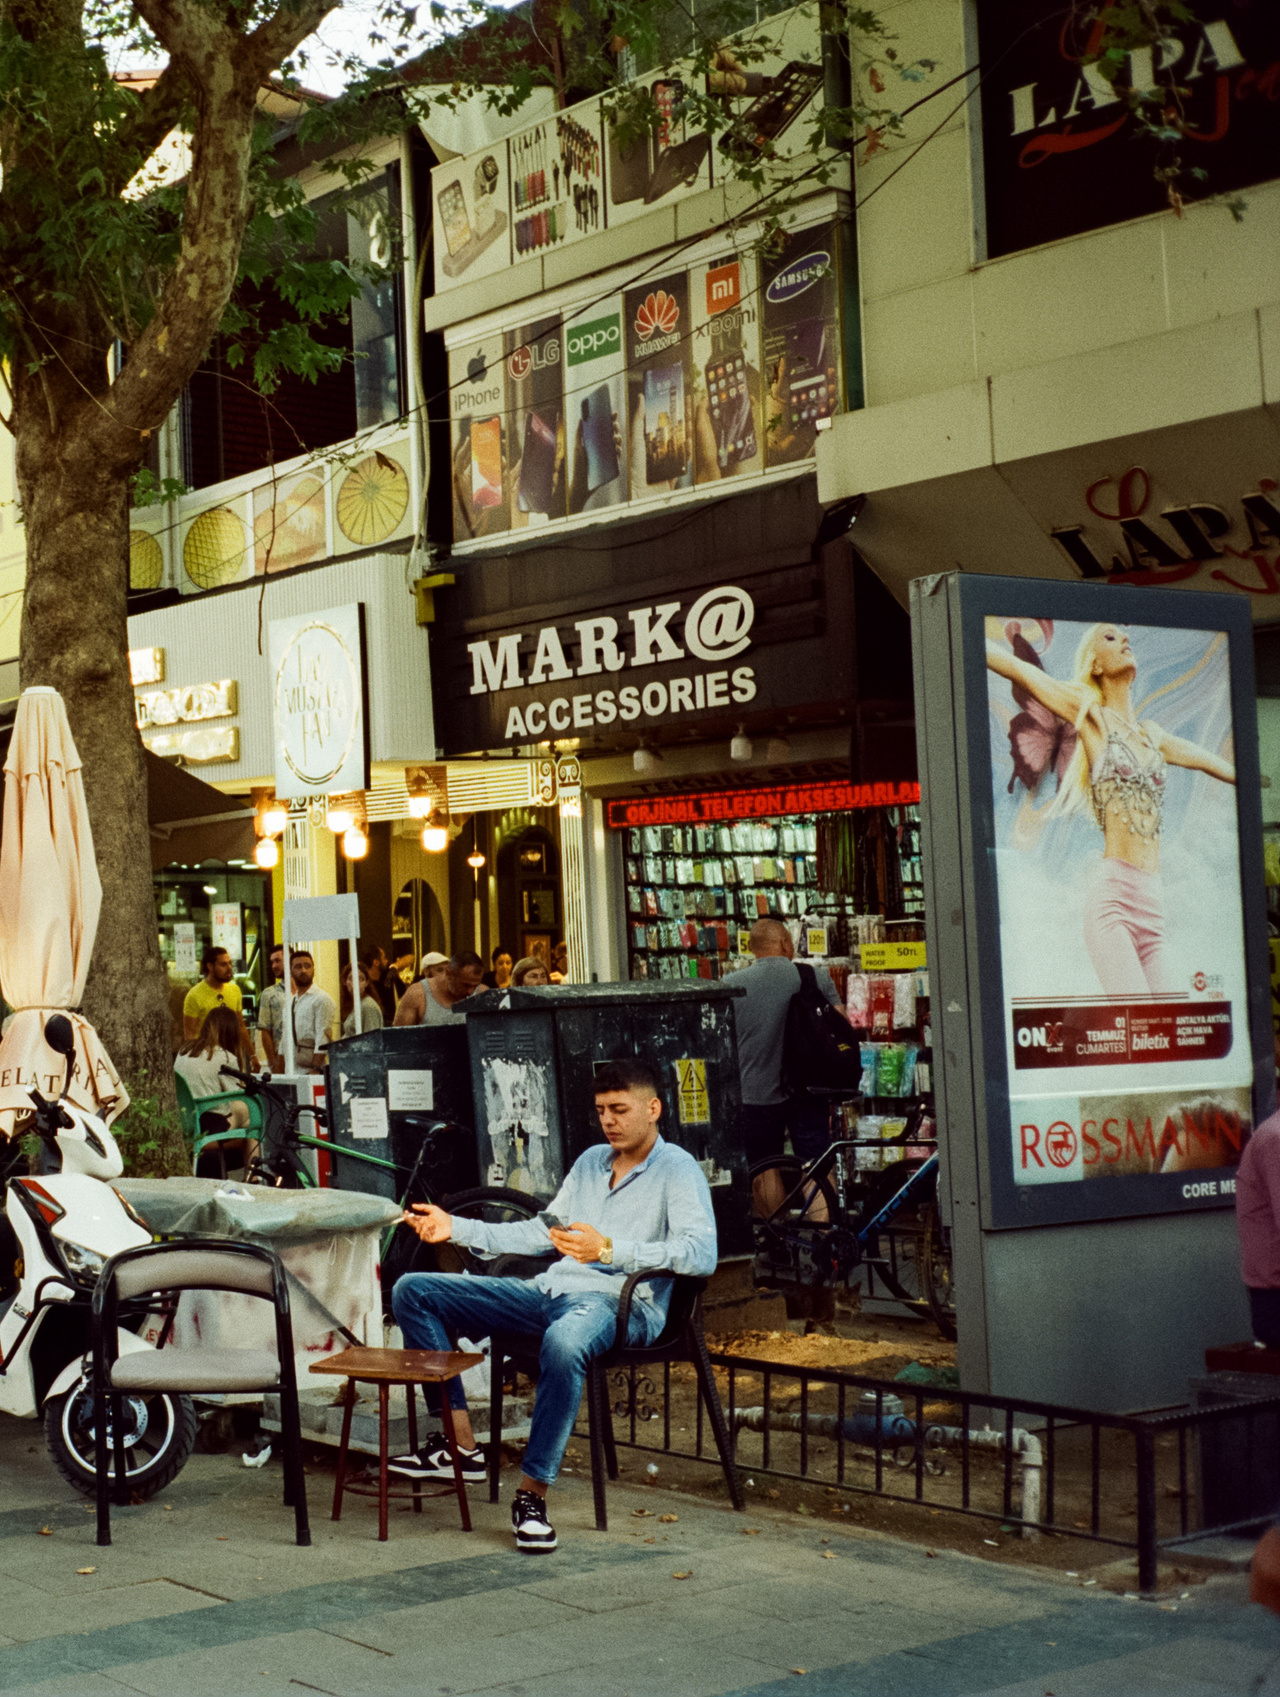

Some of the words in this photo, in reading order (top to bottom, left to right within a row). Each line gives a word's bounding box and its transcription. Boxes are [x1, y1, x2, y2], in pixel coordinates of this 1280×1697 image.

[1008, 20, 1246, 136] LAPA
[775, 265, 824, 290] SAMSUG
[568, 326, 619, 355] oppo
[635, 332, 682, 358] HUAWEI
[533, 339, 560, 370] LG
[454, 386, 501, 412] iPhone
[468, 586, 755, 695] MARK@
[505, 666, 757, 739] ACCESSORIES
[701, 792, 782, 818] TELEFON
[896, 946, 918, 957] 50TL
[1176, 1015, 1206, 1024] ANTALYA
[1176, 1026, 1193, 1036] AÇIK
[1193, 1025, 1213, 1034] HAVA
[1086, 1029, 1126, 1042] TEMMUZ
[1132, 1032, 1170, 1050] biletix
[1020, 1110, 1242, 1169] ROSSMANN
[1182, 1182, 1218, 1199] CORE
